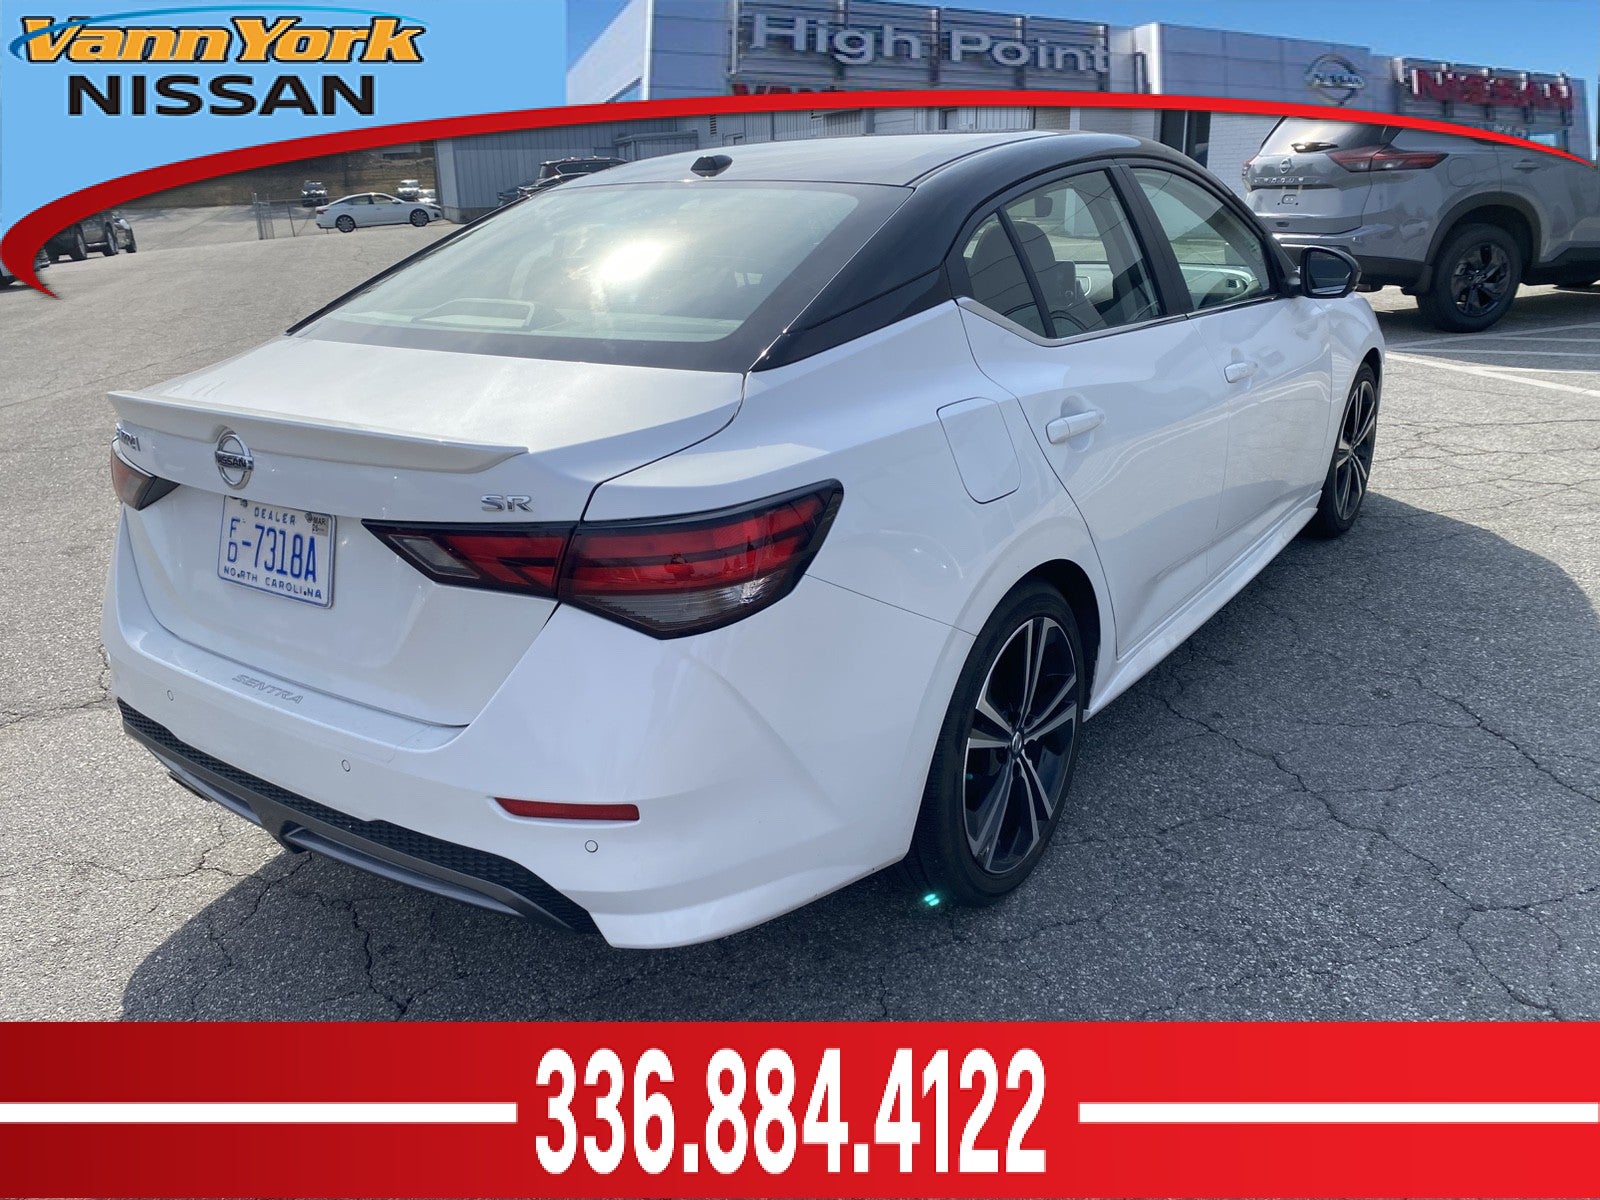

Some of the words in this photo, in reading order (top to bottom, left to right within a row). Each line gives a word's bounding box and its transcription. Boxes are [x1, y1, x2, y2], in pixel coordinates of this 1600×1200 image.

[751, 13, 922, 65] High
[950, 29, 1110, 73] Point
[217, 453, 248, 469] NISSAN
[254, 506, 297, 526] DEALER
[481, 494, 534, 513] SR
[223, 565, 258, 583] NORTH
[265, 576, 322, 600] CAROLINA
[231, 674, 304, 704] SENTRA
